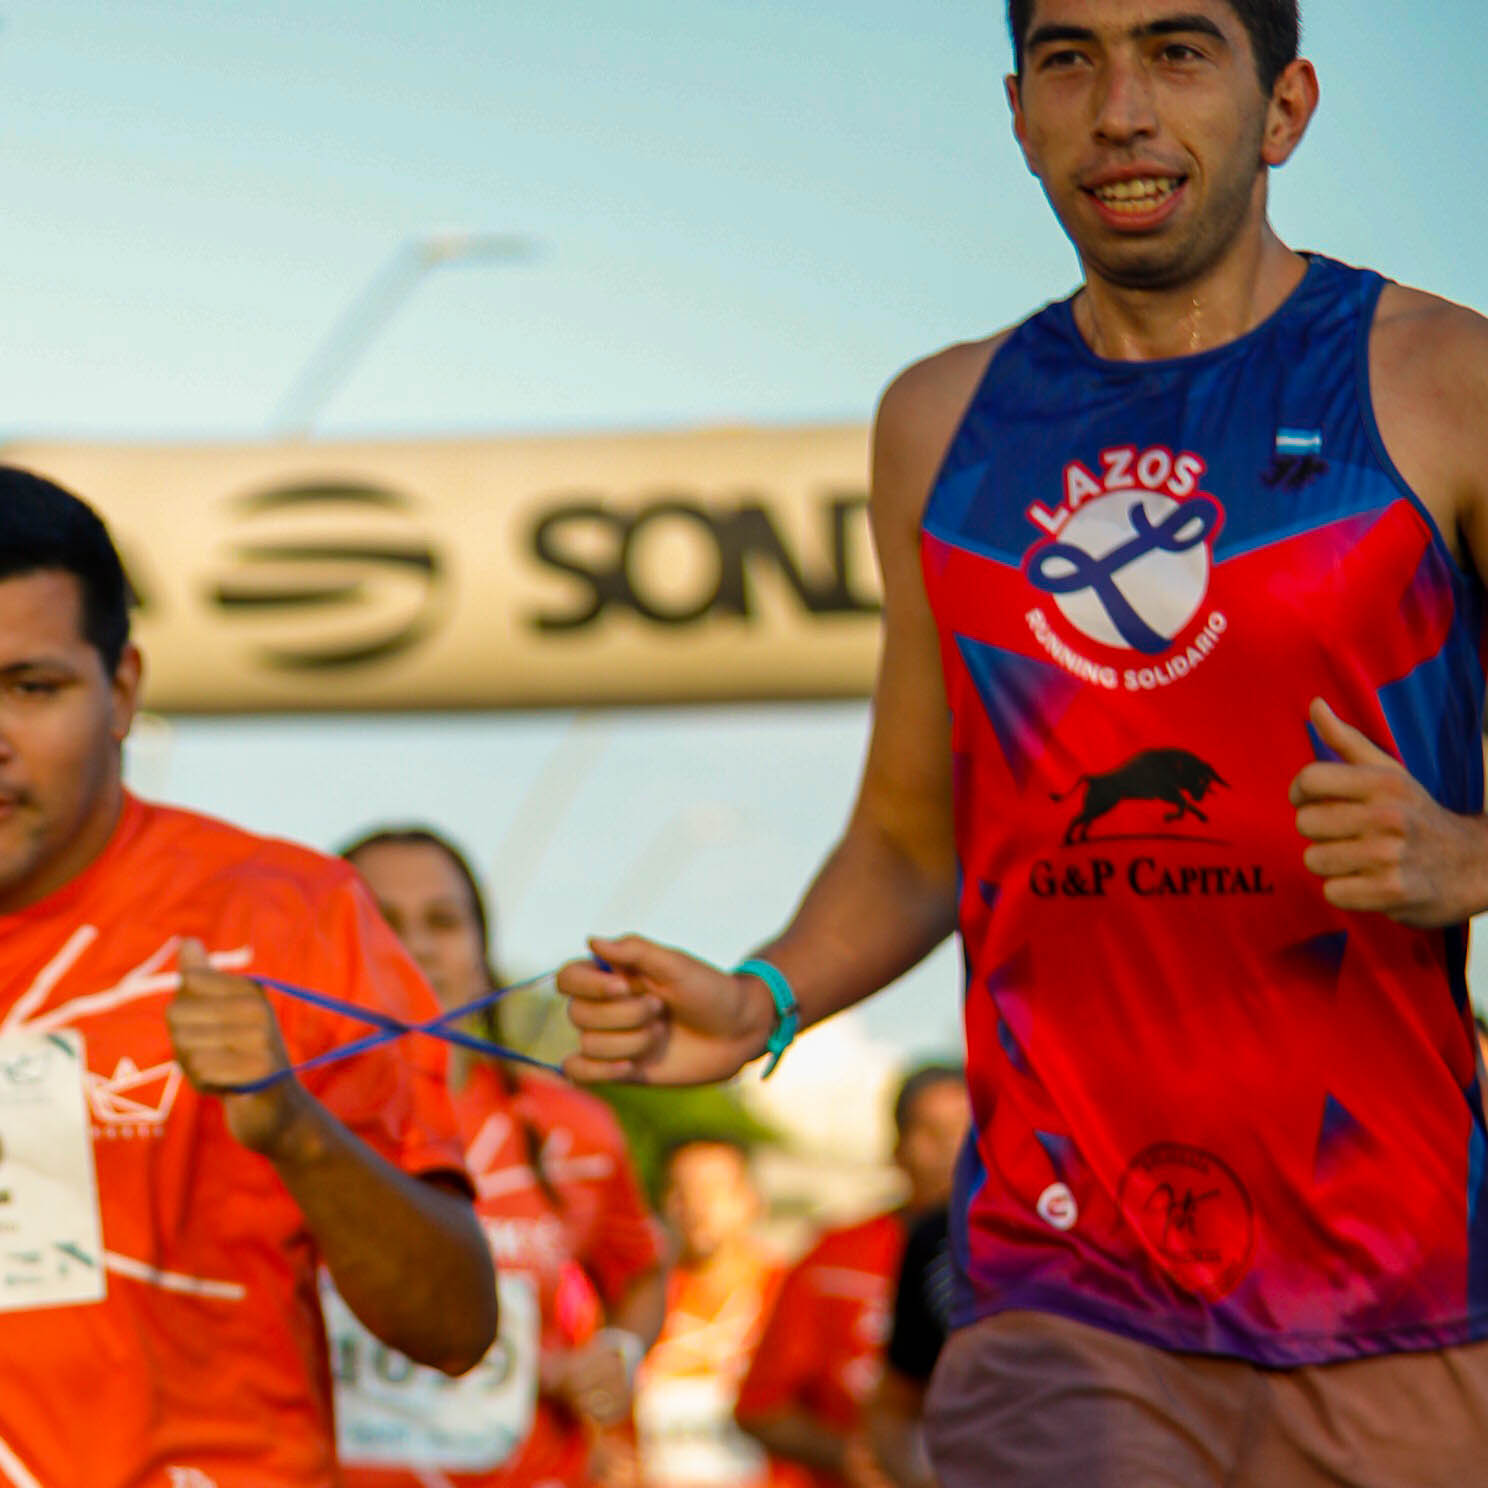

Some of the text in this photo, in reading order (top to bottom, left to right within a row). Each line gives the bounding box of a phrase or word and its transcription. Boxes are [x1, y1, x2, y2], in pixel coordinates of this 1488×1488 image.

[1029, 448, 1203, 533] LAZOS
[1025, 607, 1228, 691] RUNNING SOLIDARIO
[1029, 857, 1115, 897] G&P
